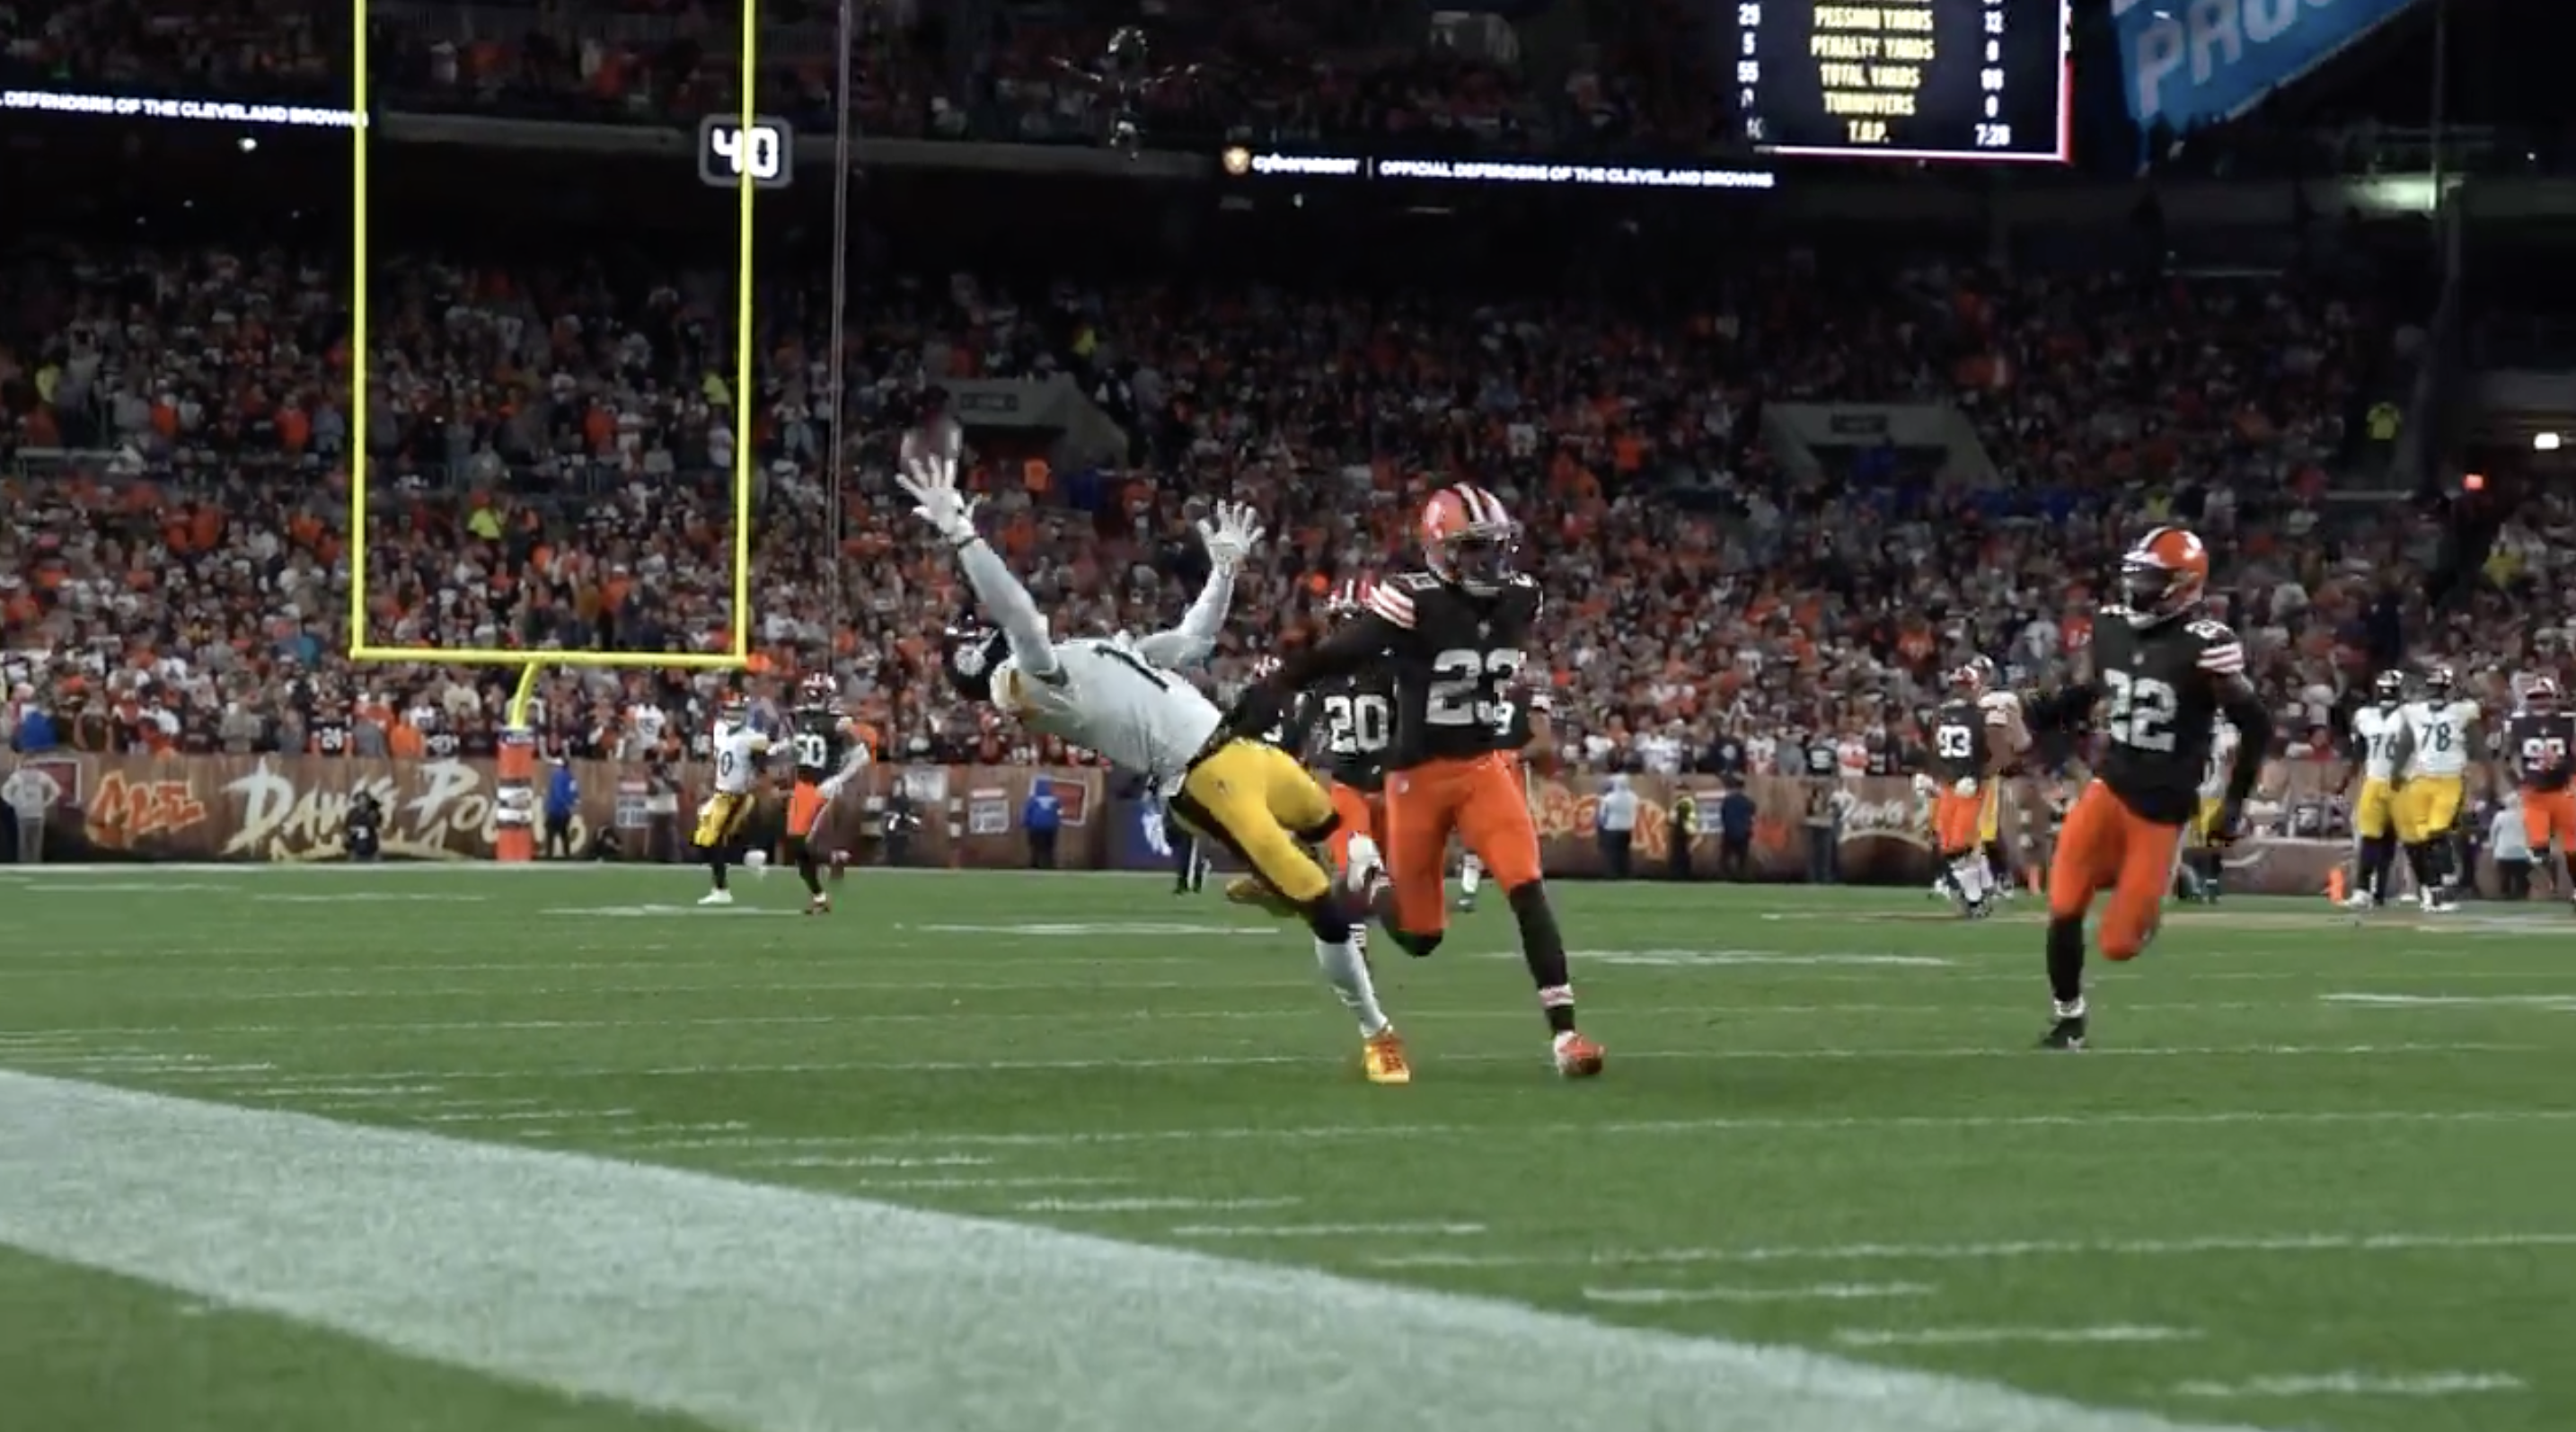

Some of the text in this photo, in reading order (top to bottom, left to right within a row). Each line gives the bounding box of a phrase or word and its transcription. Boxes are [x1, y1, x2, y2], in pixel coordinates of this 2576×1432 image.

[1883, 8, 1933, 31] YARDS
[1810, 34, 1935, 60] PENALTY YARDS
[1820, 63, 1920, 89] TOTAL YARDS
[4, 91, 113, 112] DEFENDERS
[116, 98, 139, 112] OF
[143, 100, 178, 116] THE
[181, 102, 287, 122] CLEVELAND
[1822, 91, 1916, 116] TURNOVERS
[712, 128, 779, 178] 40
[1380, 161, 1774, 188] OFFICIAL DEFENDERS OF THE CLEVELAND BROWNS
[1325, 694, 1389, 753] 20
[2422, 721, 2451, 751] 78
[1937, 725, 1971, 757] 93
